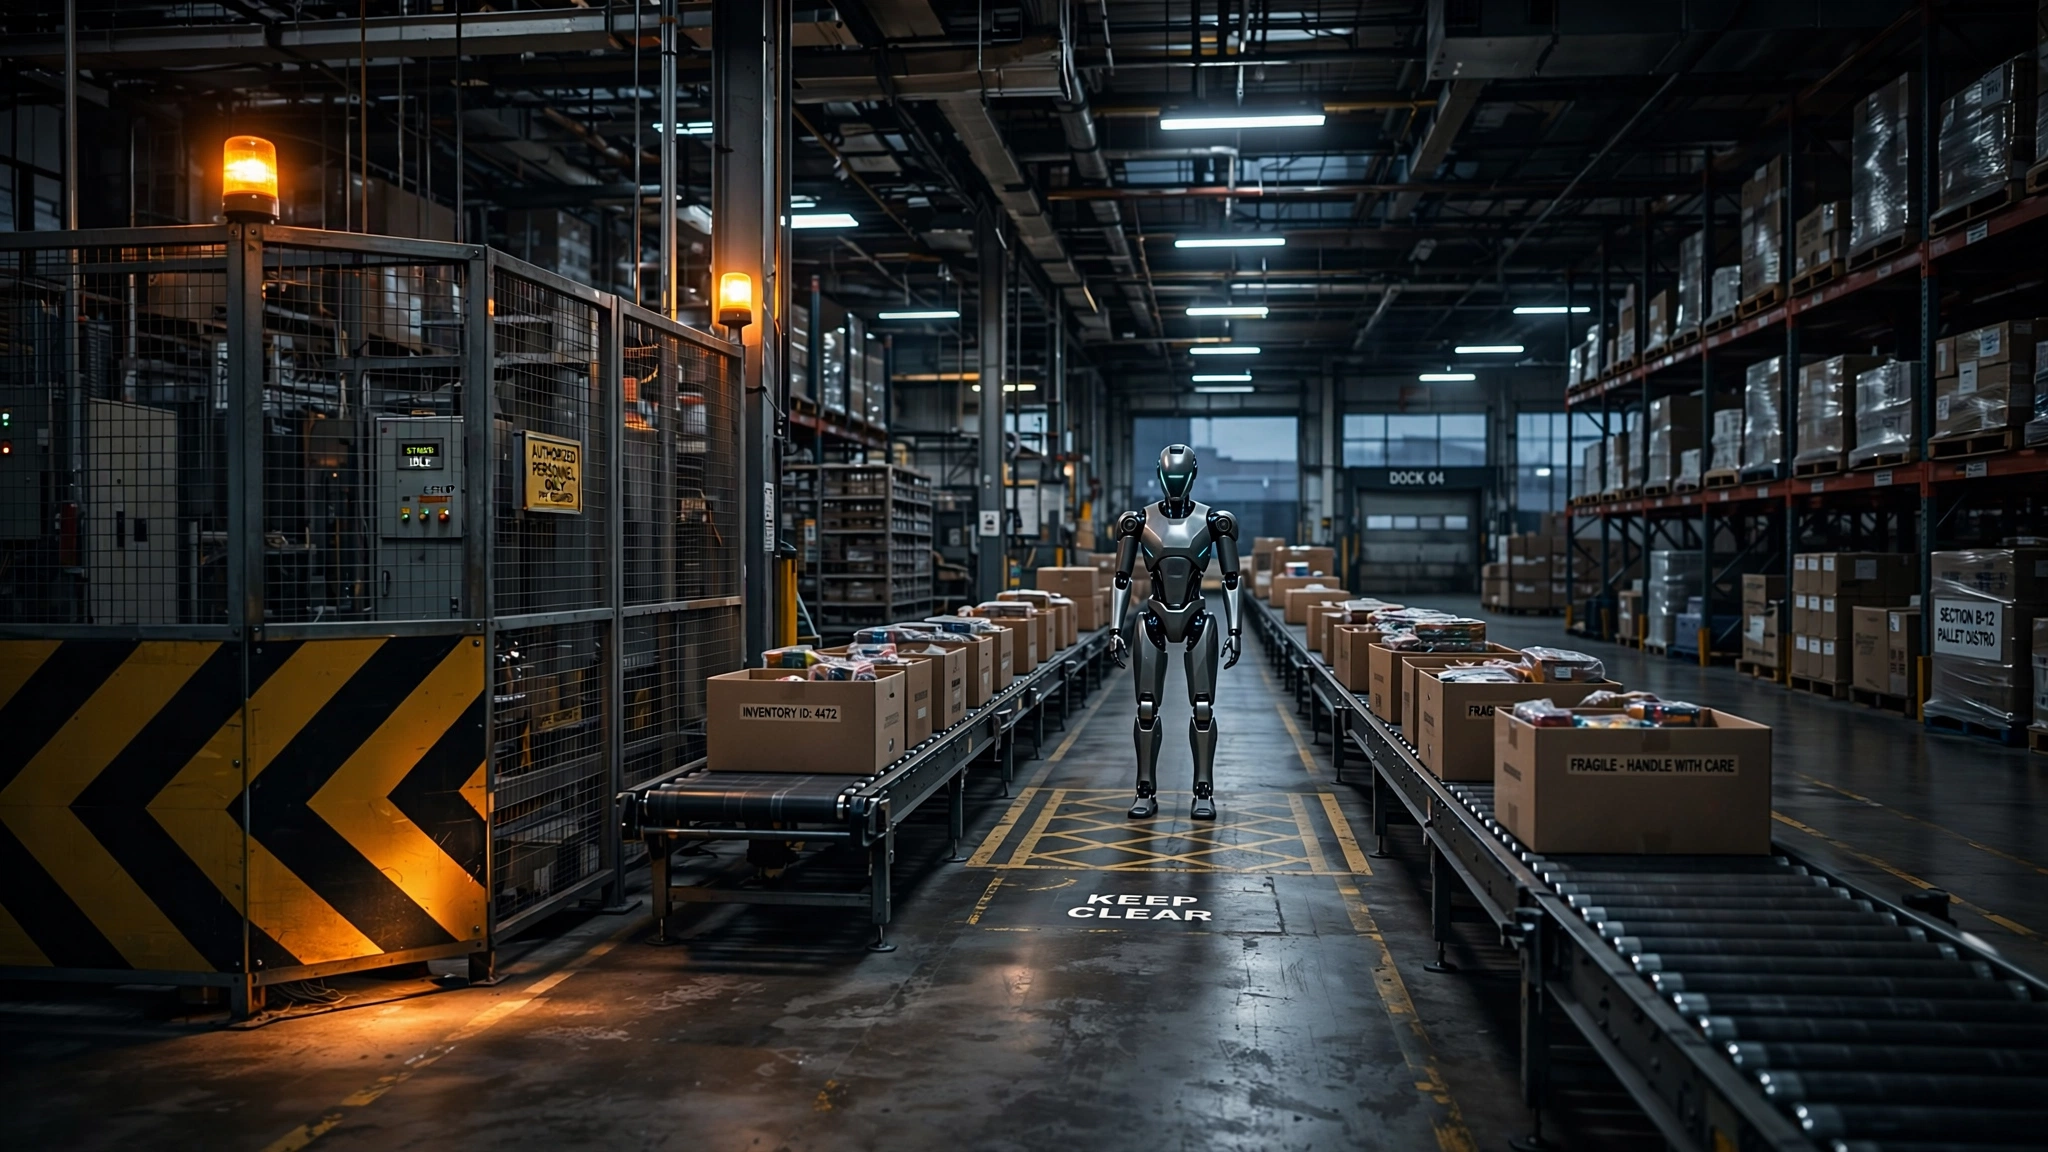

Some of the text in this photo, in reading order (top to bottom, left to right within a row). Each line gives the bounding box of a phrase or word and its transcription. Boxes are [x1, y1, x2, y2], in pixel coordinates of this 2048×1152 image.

[1388, 470, 1445, 485] DOCK 04
[1940, 606, 1996, 627] SECTION B-12
[1938, 627, 1965, 643] PALLET
[742, 706, 838, 719] INVENTORY ID: 4472
[1570, 757, 1618, 772] FRAGILE
[1626, 758, 1673, 773] HANDLE
[1674, 759, 1703, 773] WITH
[1704, 759, 1735, 773] CARE
[1087, 894, 1198, 907] KEEP
[1067, 907, 1214, 921] CLEAR
